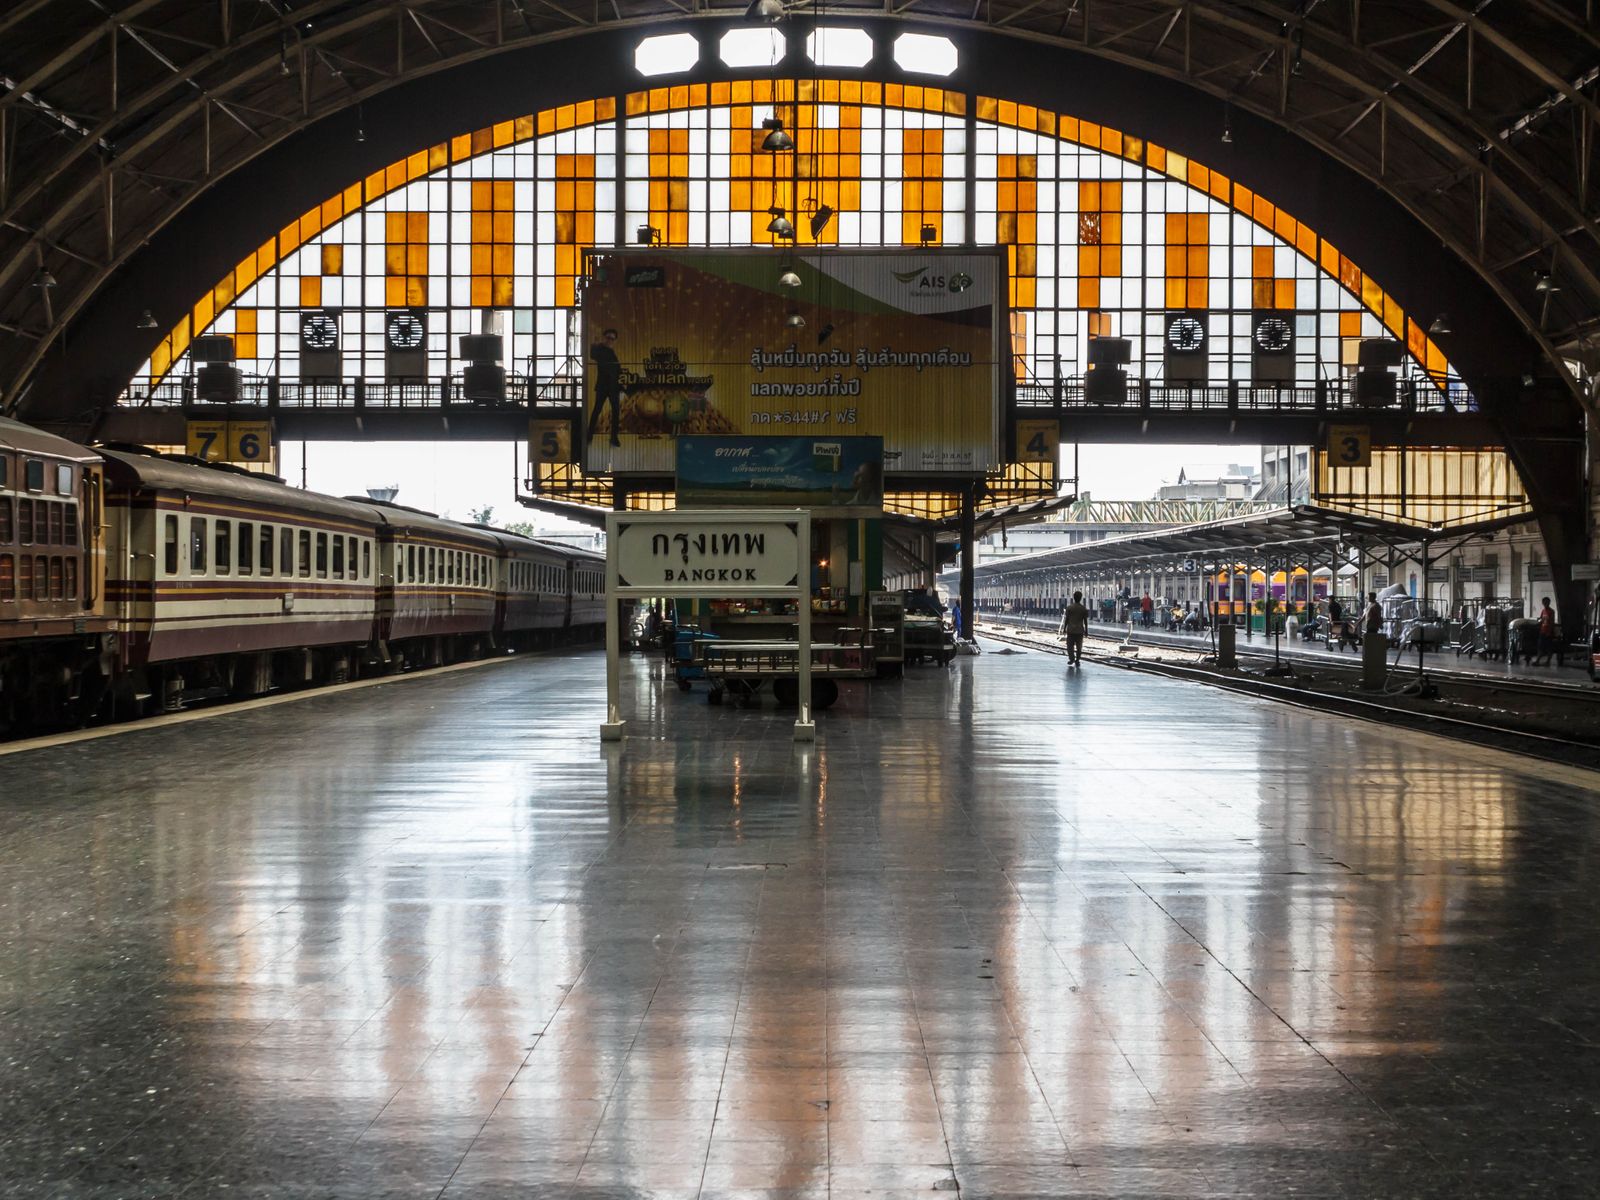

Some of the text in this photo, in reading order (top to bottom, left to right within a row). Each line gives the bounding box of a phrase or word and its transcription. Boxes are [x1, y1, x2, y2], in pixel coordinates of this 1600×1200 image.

[919, 276, 945, 288] AIS
[751, 344, 972, 372] ลุ้นหมื่นทุกวัน ลุ้นล้านทุกเดือน
[750, 373, 861, 396] แลกพอยท์ทั้งปี
[836, 408, 857, 424] ฟรี
[196, 432, 218, 459] 7
[239, 433, 260, 459] 6
[542, 432, 560, 458] 5
[1026, 431, 1050, 456] 4
[1341, 436, 1361, 462] 3
[652, 533, 766, 564] กรุงเทพ
[664, 568, 757, 582] BANGKOK
[1185, 559, 1195, 572] 3
